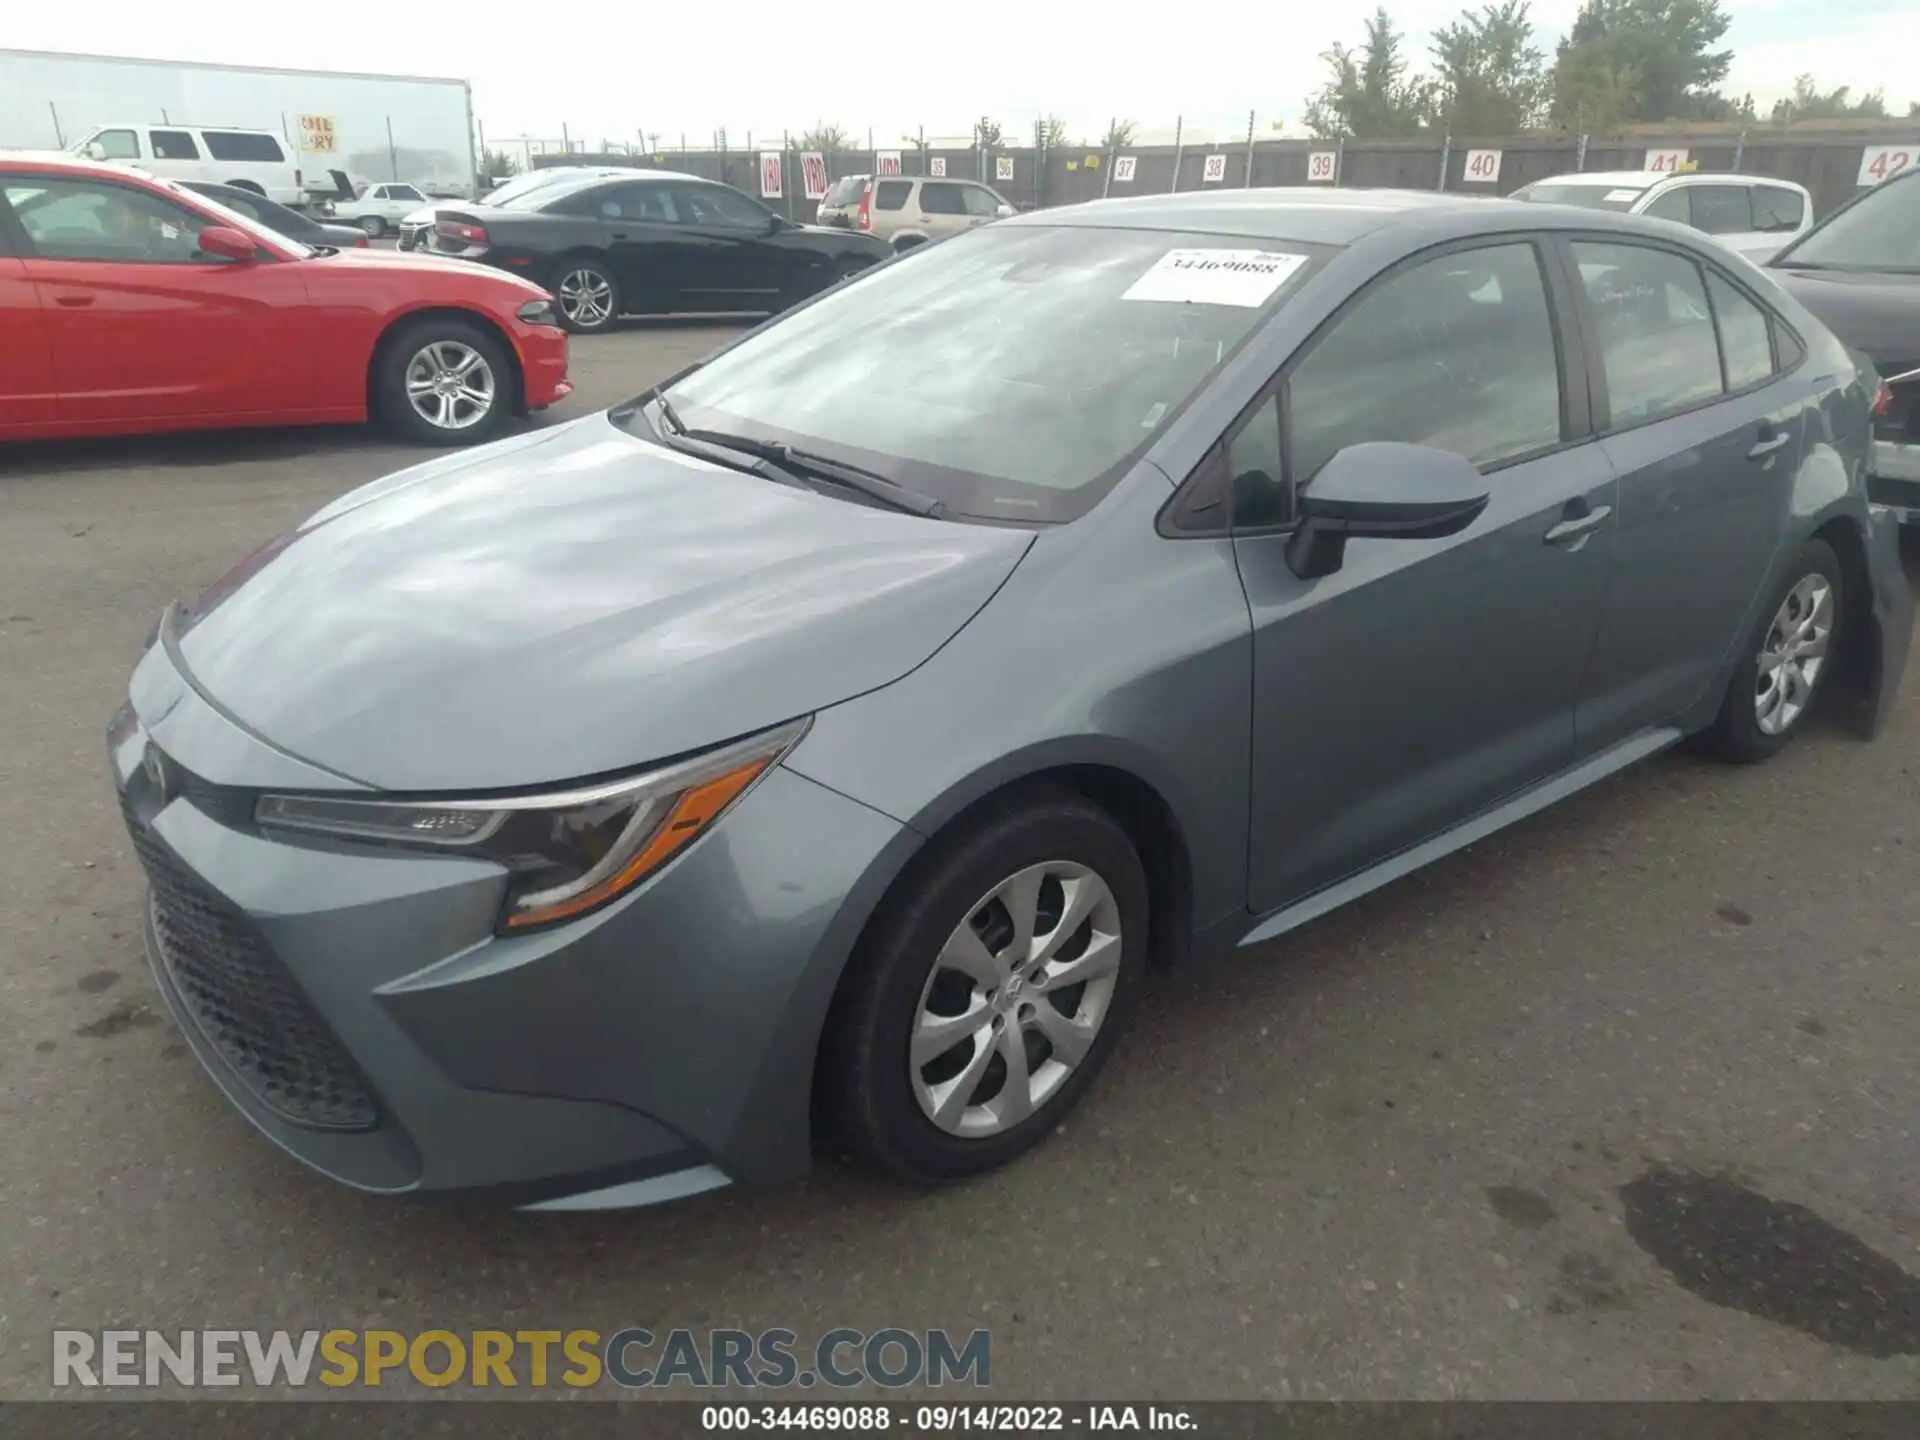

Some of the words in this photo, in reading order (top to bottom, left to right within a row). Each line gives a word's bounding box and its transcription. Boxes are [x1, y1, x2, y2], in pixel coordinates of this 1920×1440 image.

[1117, 159, 1134, 177] 37
[1207, 158, 1222, 176] 38
[1312, 155, 1332, 176] 39
[1470, 154, 1495, 176] 40
[1651, 154, 1678, 172] 41
[1868, 151, 1909, 179] 42
[803, 155, 827, 193] VRD
